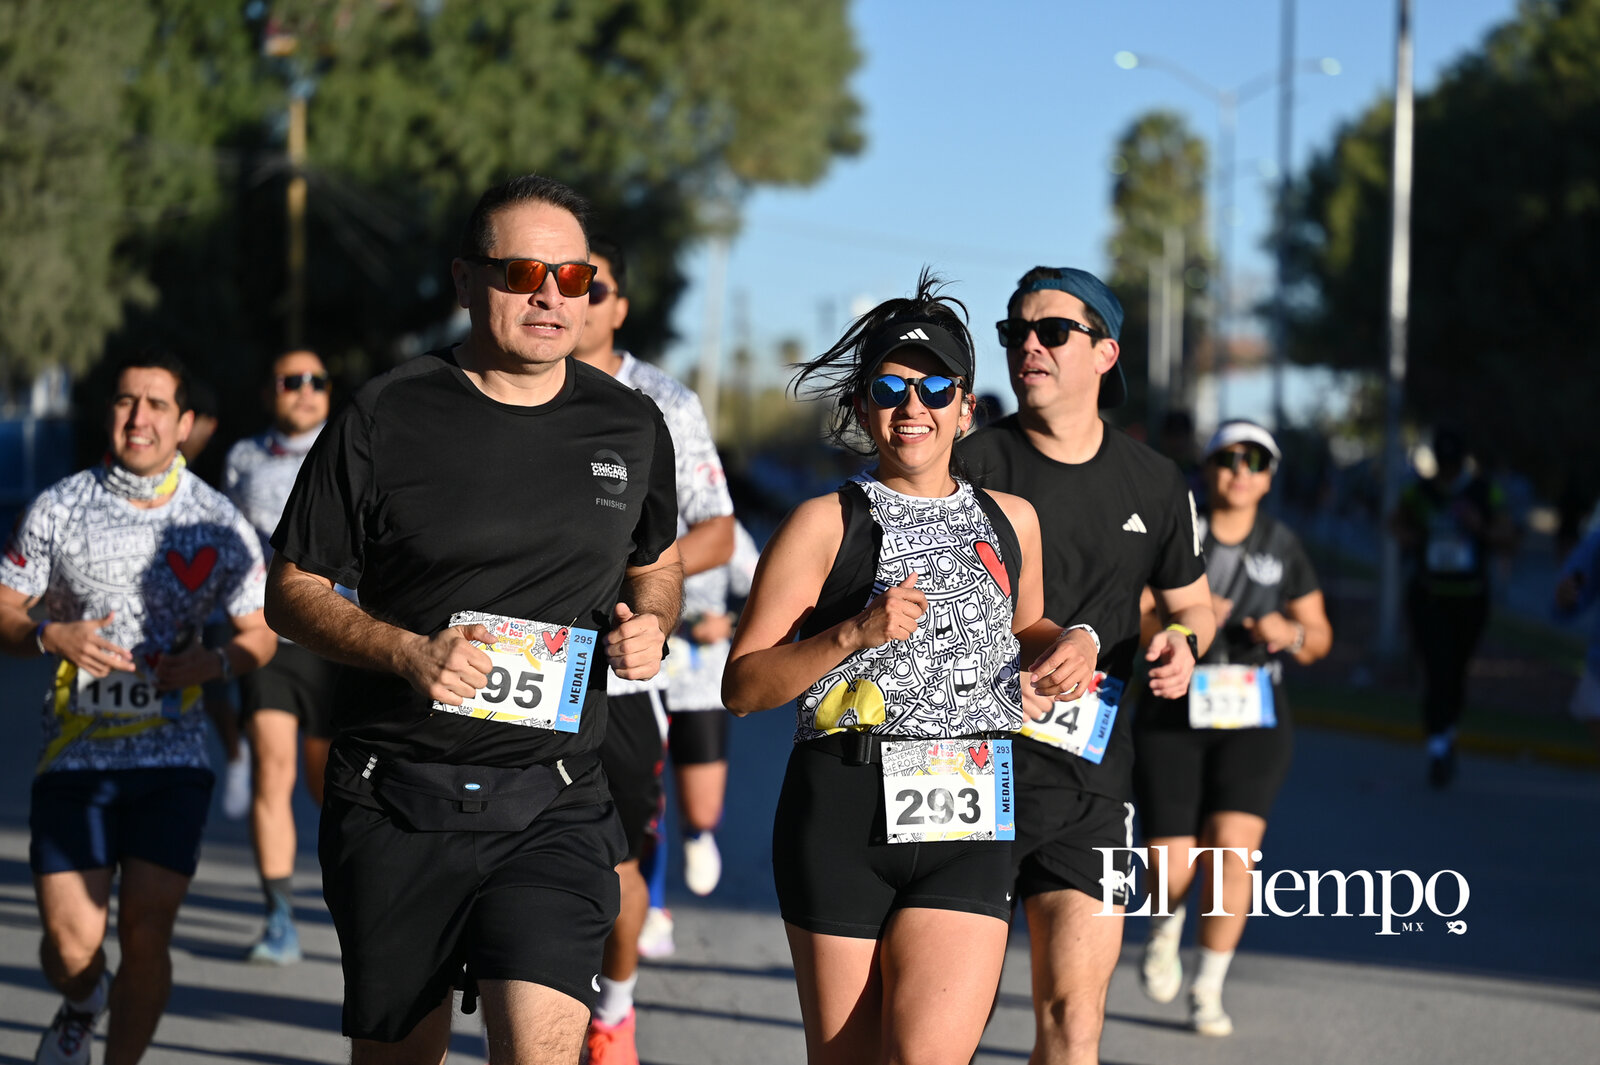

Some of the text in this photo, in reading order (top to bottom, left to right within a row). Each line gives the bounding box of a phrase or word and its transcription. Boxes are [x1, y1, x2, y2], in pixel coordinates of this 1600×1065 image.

[592, 465, 628, 478] CHICAGO
[595, 498, 627, 511] FINISHER
[574, 634, 593, 645] 295
[86, 680, 163, 708] 116
[468, 665, 545, 709] 95
[569, 652, 588, 705] MEDALLA
[1003, 761, 1011, 813] MEDALLA
[895, 787, 982, 825] 293
